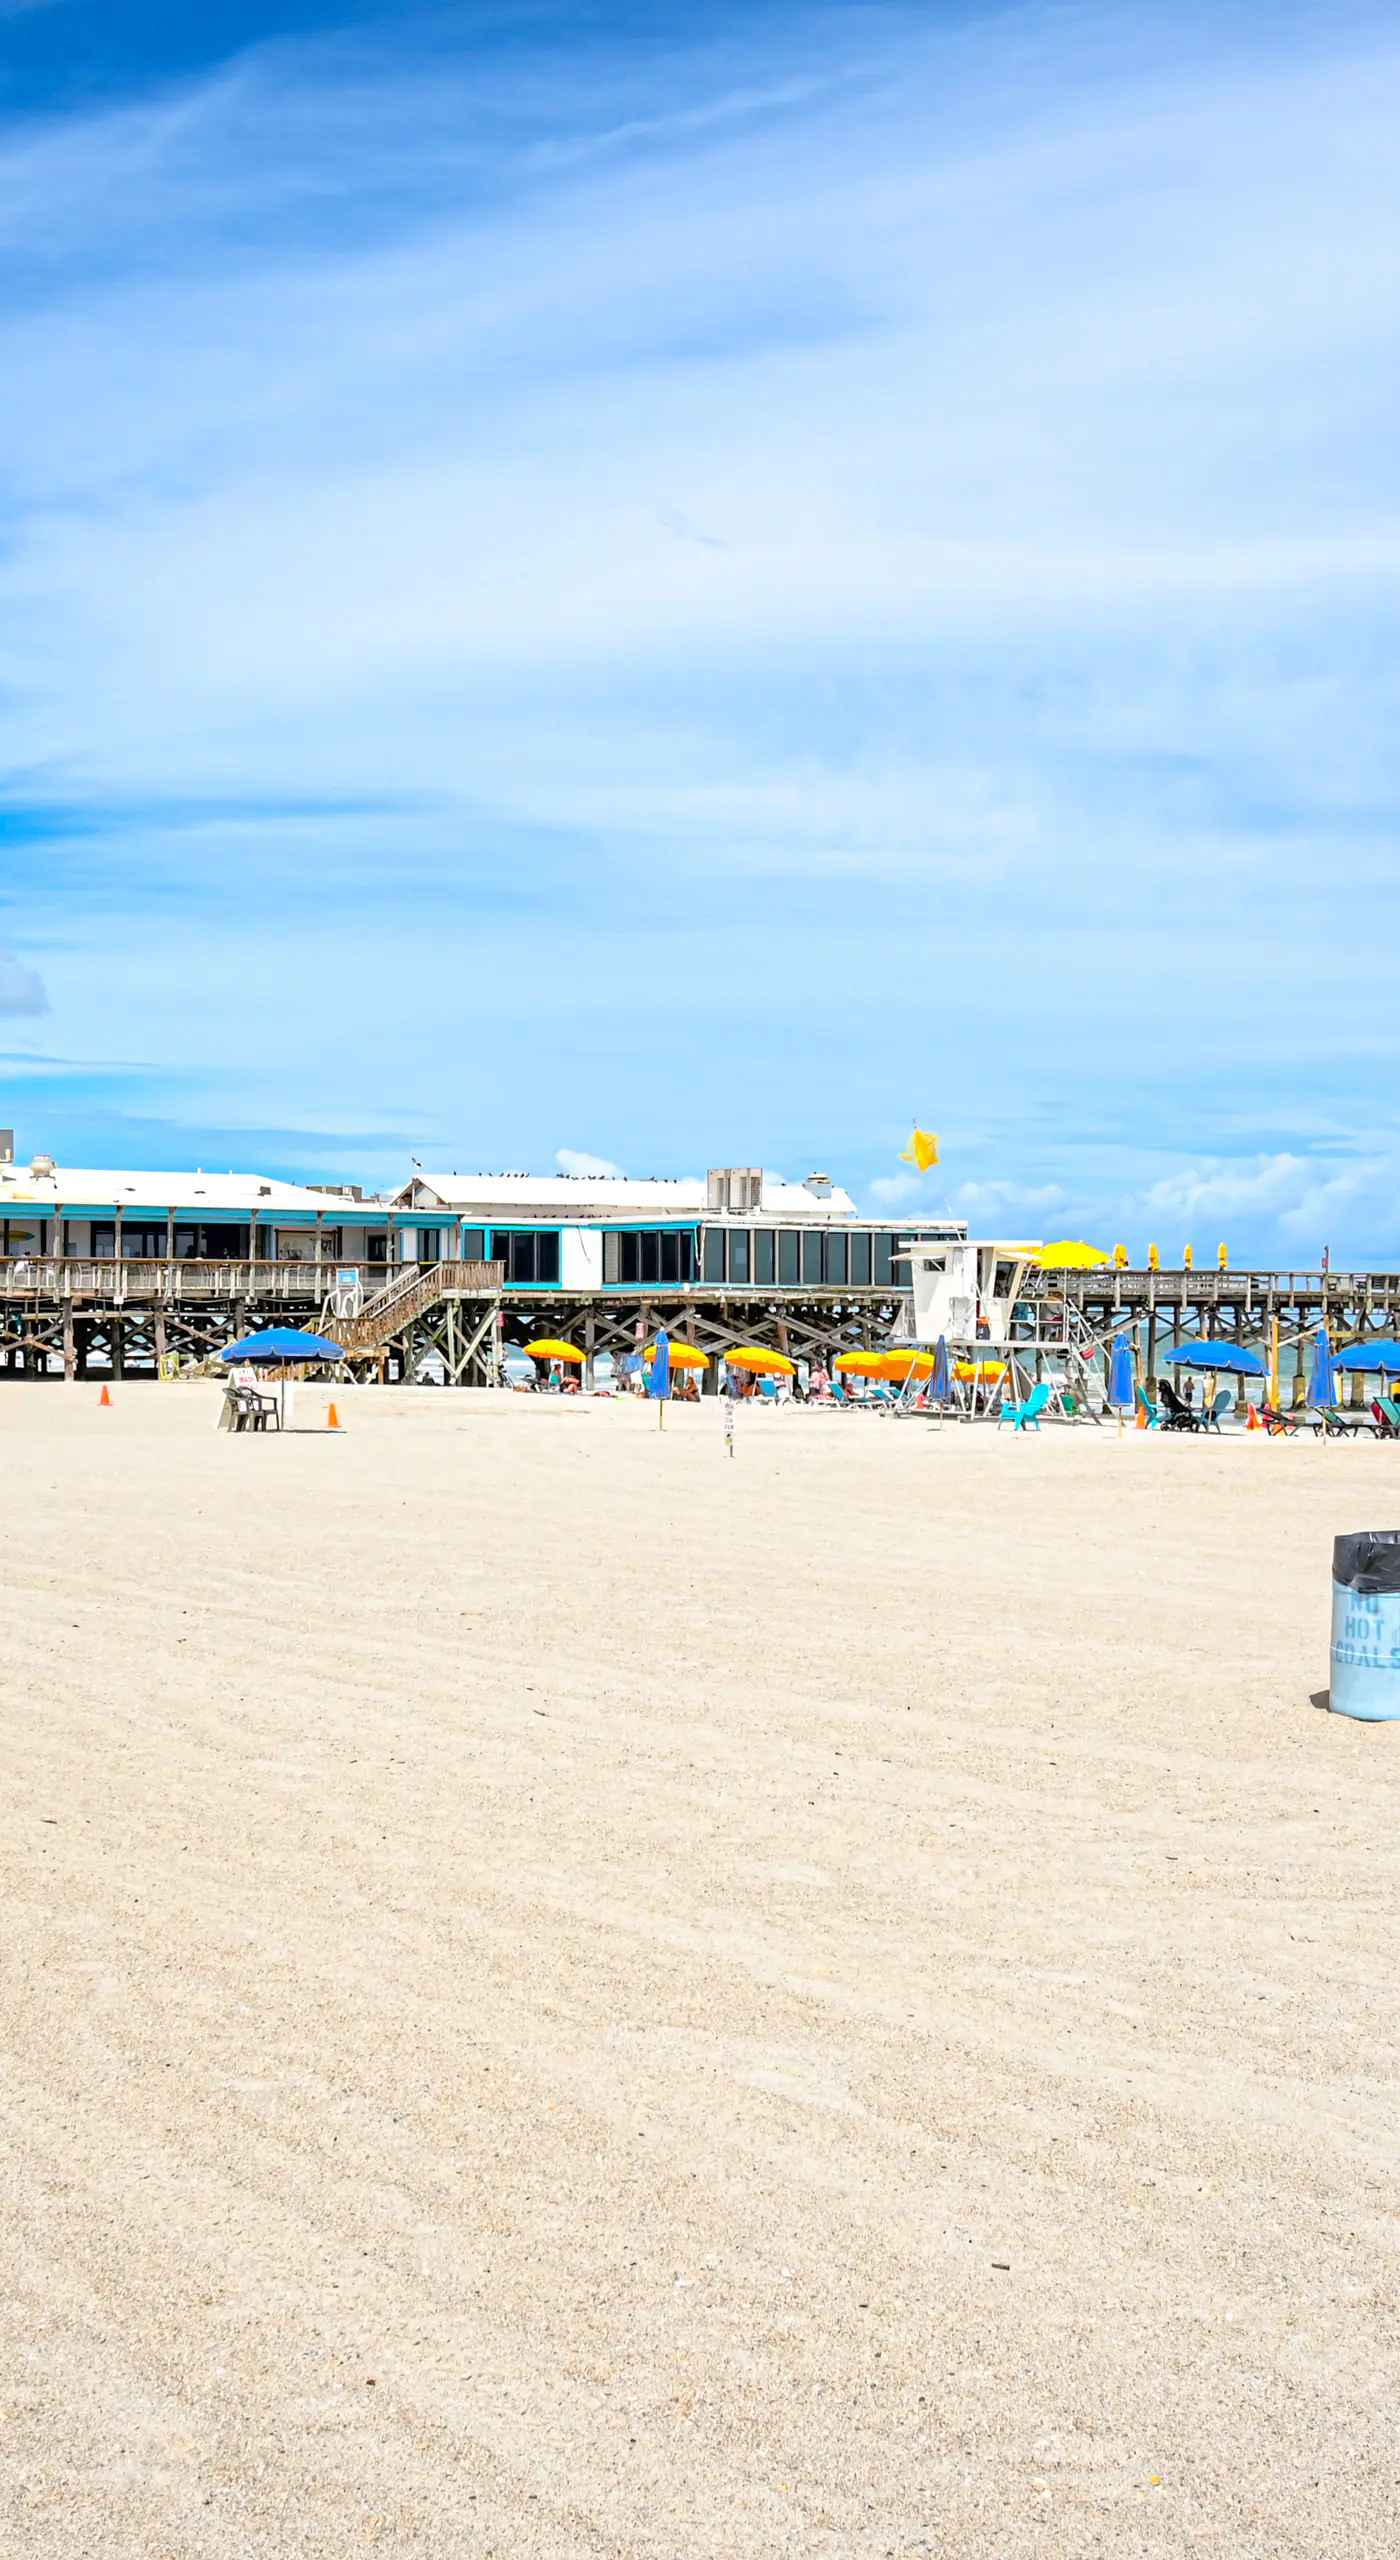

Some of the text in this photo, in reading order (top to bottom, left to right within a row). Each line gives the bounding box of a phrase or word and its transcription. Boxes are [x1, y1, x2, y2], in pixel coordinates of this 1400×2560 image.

[1351, 1593, 1380, 1613] NO
[1345, 1615, 1385, 1641] HOT
[1335, 1640, 1400, 1669] COALS
